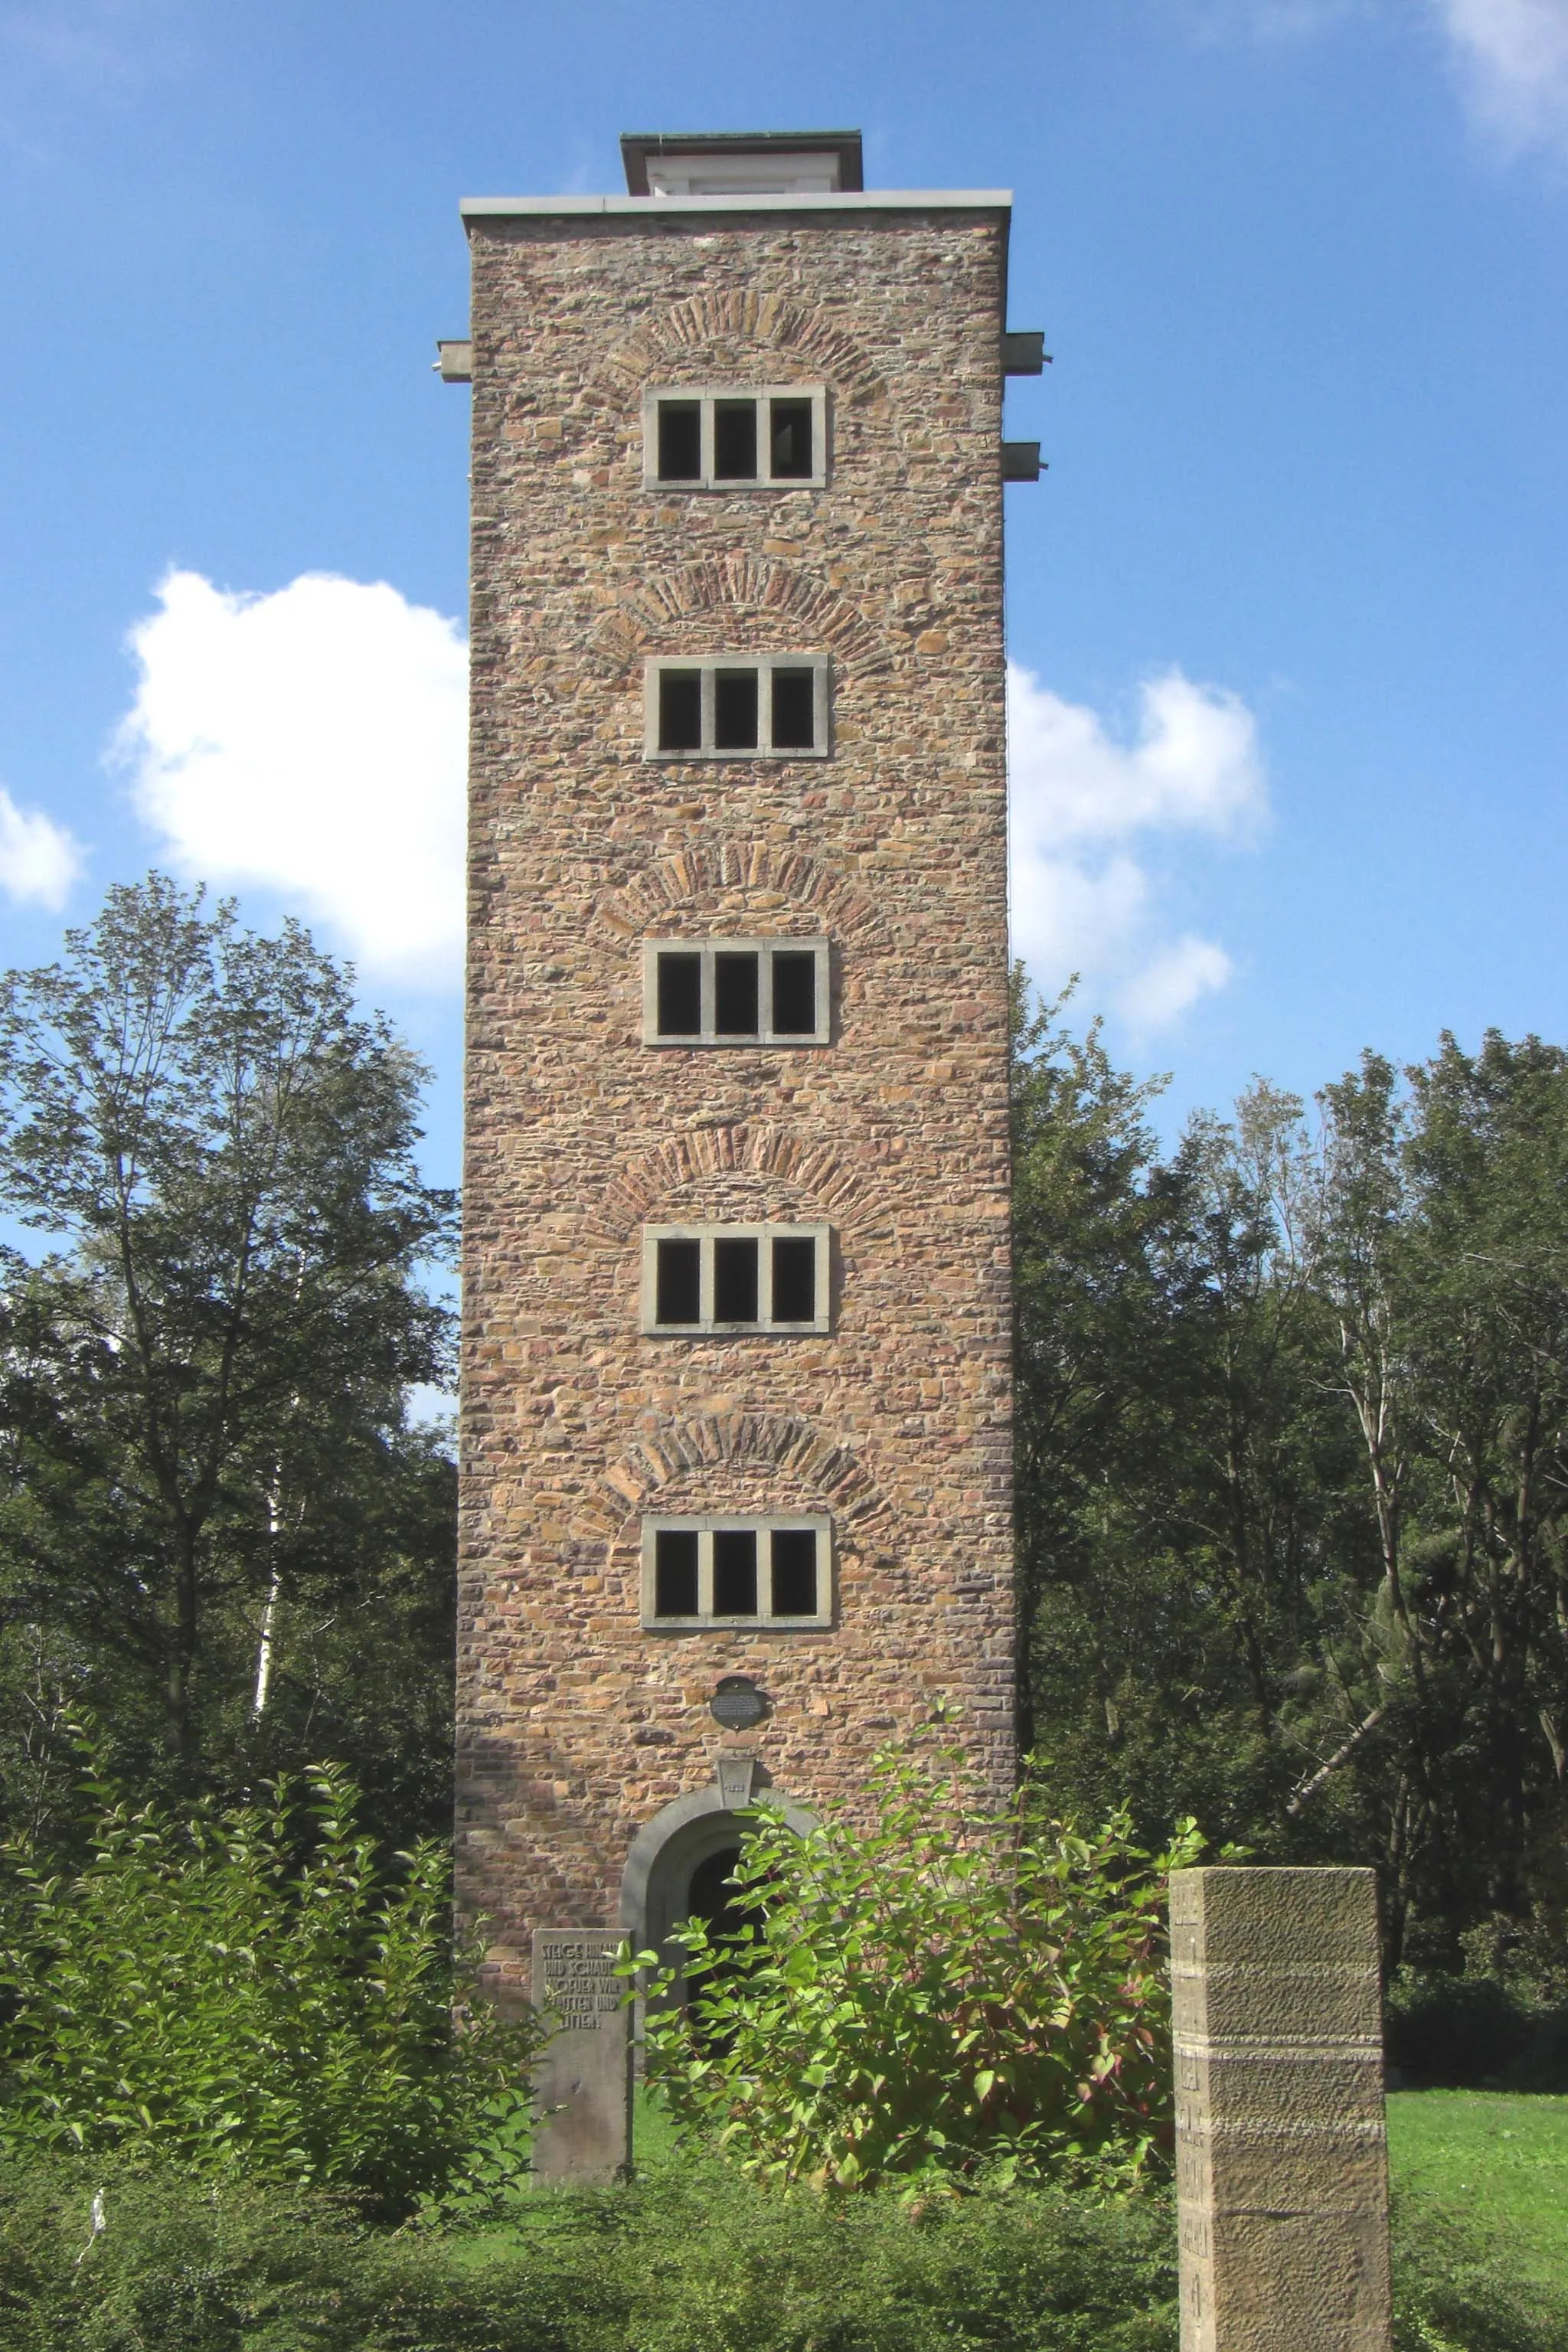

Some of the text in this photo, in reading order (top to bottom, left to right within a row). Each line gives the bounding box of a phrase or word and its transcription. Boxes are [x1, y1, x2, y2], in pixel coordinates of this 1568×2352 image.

[541, 1942, 583, 1959] STEIGE
[544, 1960, 567, 1977] UND
[596, 1978, 621, 1994] WIR
[596, 1995, 619, 2012] UND
